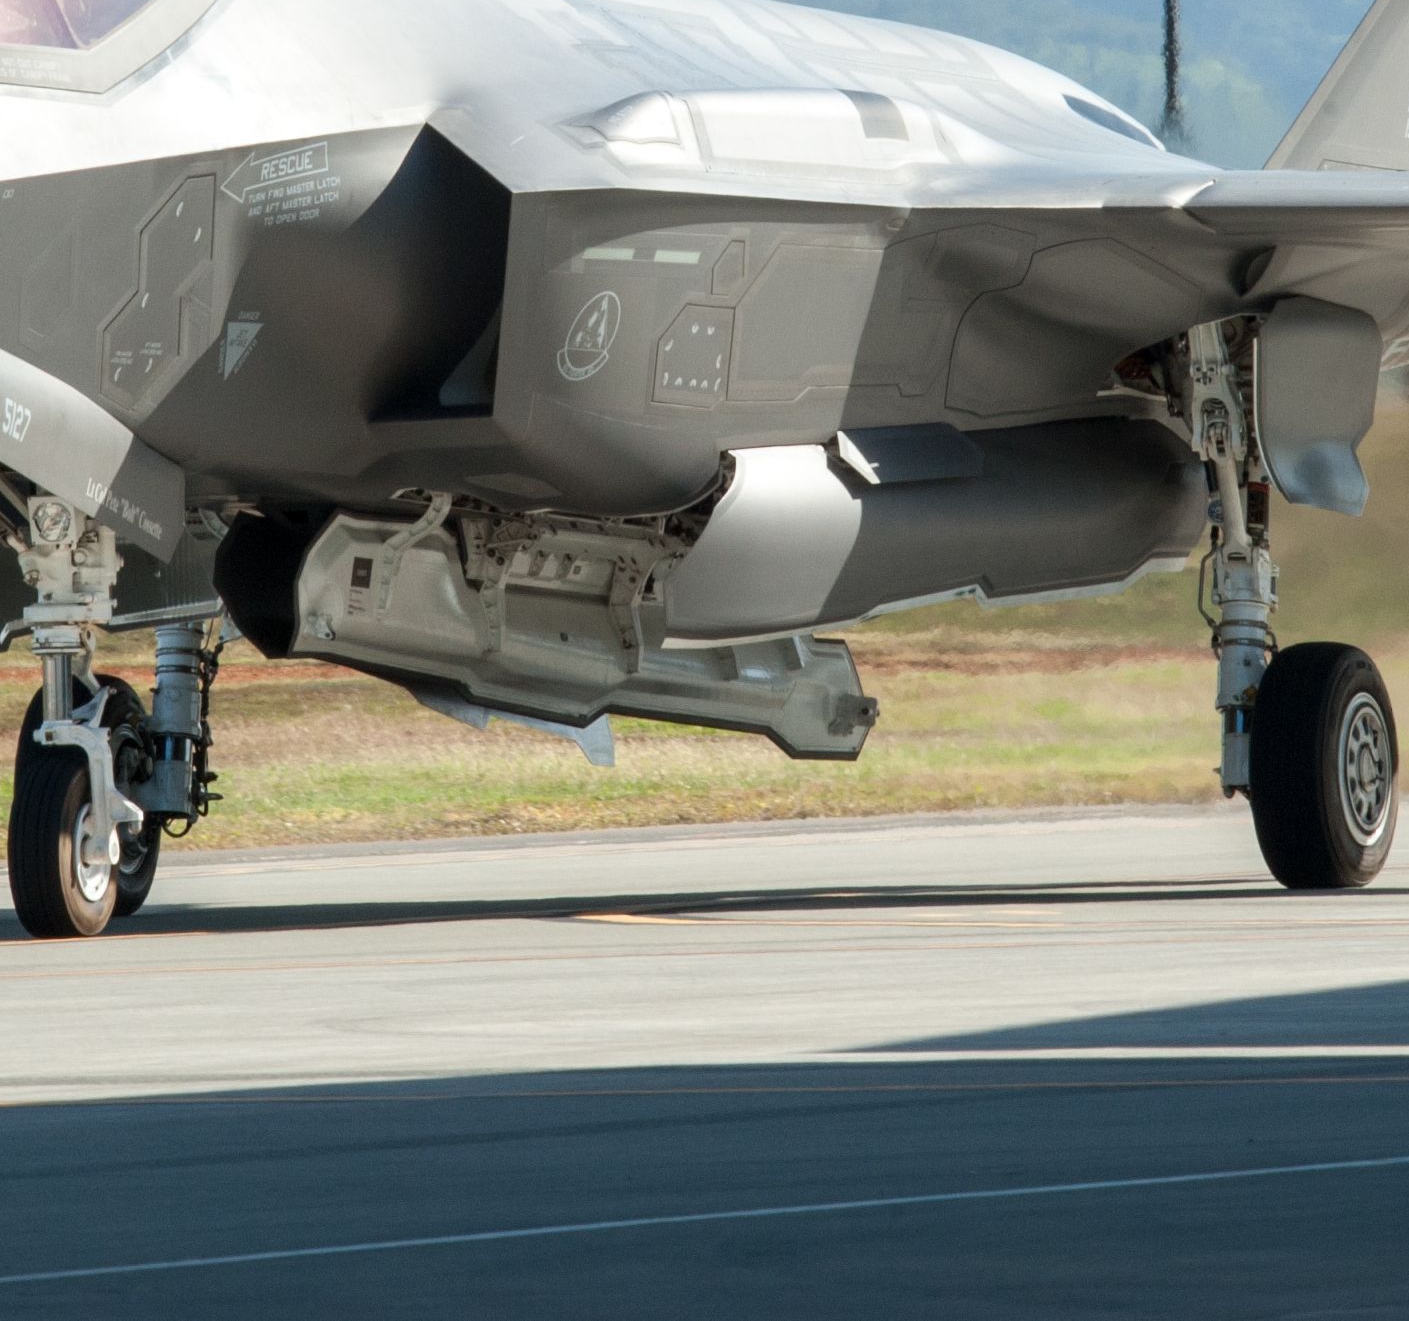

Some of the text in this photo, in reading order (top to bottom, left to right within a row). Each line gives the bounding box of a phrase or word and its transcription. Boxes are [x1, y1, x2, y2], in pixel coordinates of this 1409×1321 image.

[261, 151, 312, 180] RESCUE
[268, 188, 284, 199] FWD
[287, 182, 314, 195] MASTER
[316, 177, 341, 189] LATCH
[248, 191, 339, 217] AND AFT MASTER LATCH
[264, 209, 320, 226] TO OPEN DOOR
[2, 397, 32, 443] 5127
